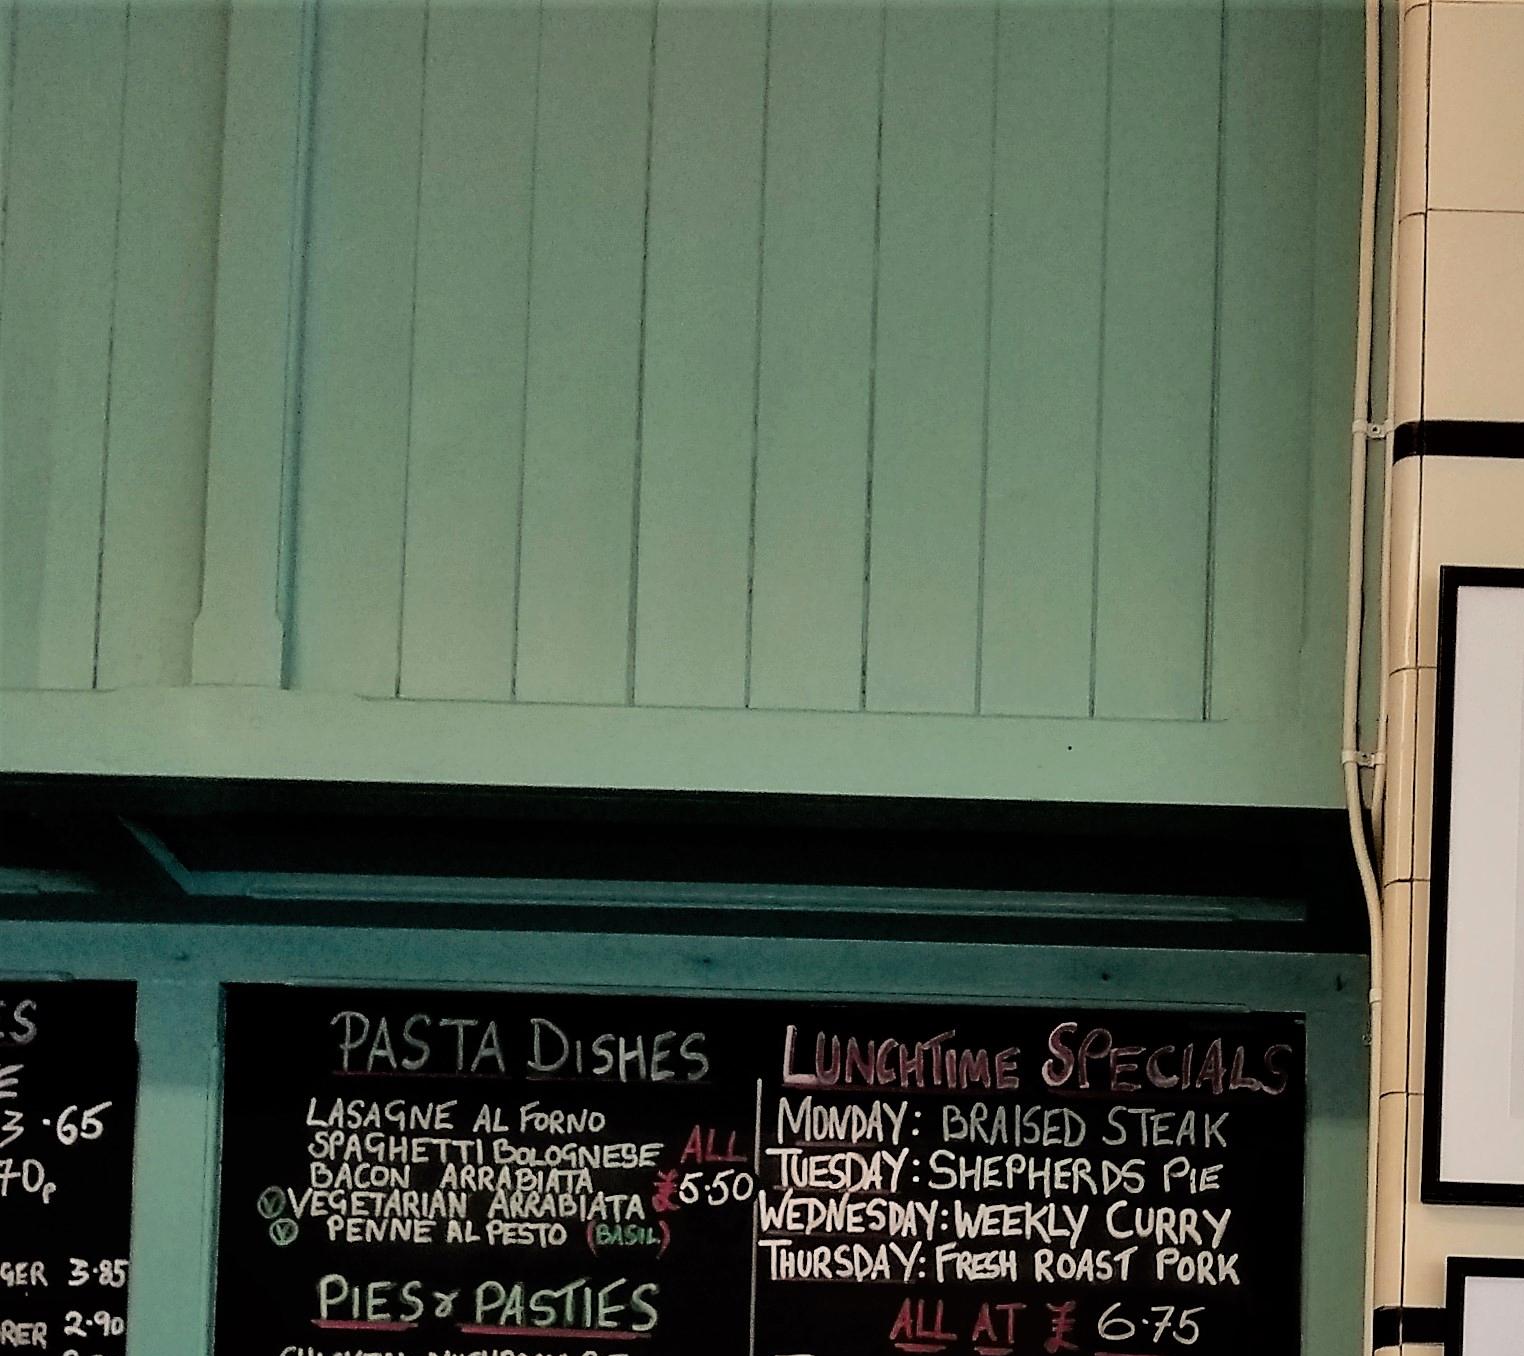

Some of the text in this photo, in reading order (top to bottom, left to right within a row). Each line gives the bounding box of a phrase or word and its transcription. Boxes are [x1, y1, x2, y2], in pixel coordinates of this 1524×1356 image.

[331, 1011, 711, 1082] PASTA DISHES
[783, 1021, 1294, 1096] LUNCHTIME SPECIALS
[305, 1098, 606, 1135] LASAGNE AL FORNO
[776, 1095, 1231, 1149] MONDAY: BRAISED STEAK
[308, 1125, 748, 1169] SPAGHETTI BOLOGNESE ALL
[310, 1164, 594, 1194] BACON ARRABIATA
[765, 1146, 1224, 1198] TUESDAY: SHEPHERDS PIE
[287, 1186, 645, 1222] VEGETARIAN ARRABIATA
[953, 1199, 1233, 1249] WEEKLY CURRY
[328, 1217, 568, 1249] PENNE AL PESTO
[67, 1257, 129, 1288] 3.85
[934, 1241, 1241, 1286] FRESH ROAST PORK
[63, 1310, 125, 1338] 2.90
[317, 1273, 661, 1332] PIES PASTIES
[889, 1297, 1027, 1344] ALL AT
